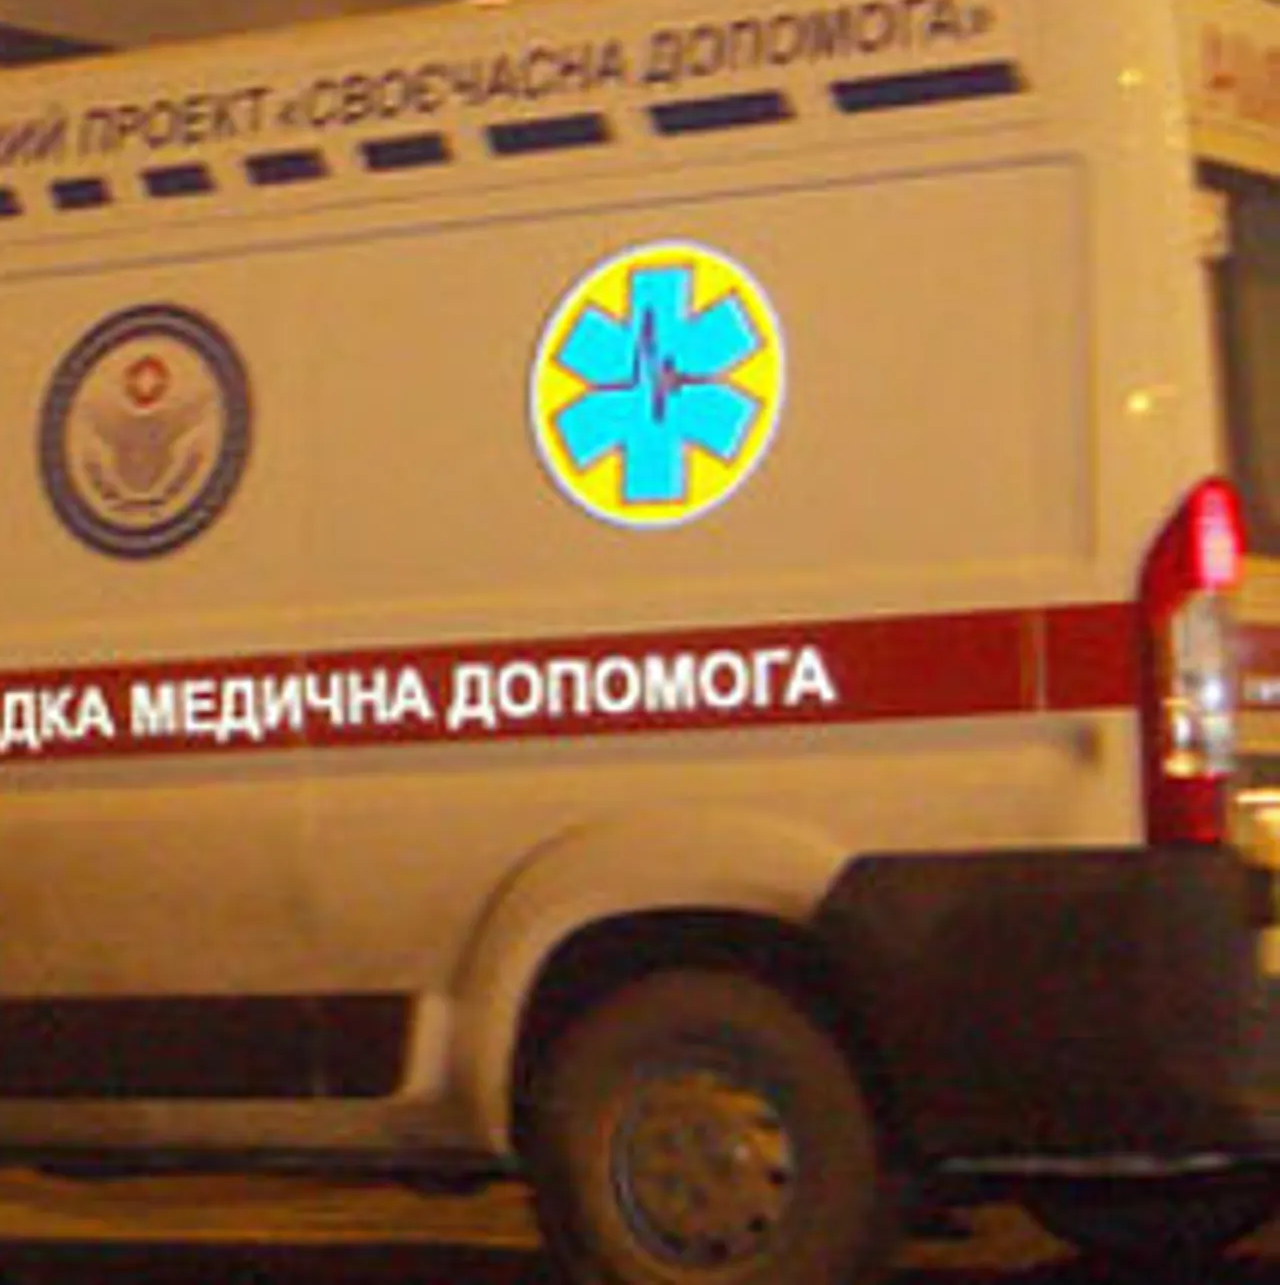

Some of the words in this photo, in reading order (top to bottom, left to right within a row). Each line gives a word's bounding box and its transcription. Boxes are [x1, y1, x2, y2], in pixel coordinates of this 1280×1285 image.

[78, 85, 273, 157] ПРОЕКТ
[129, 664, 435, 743] МЕДИЧНА
[446, 644, 837, 731] ДОПОМОГА
